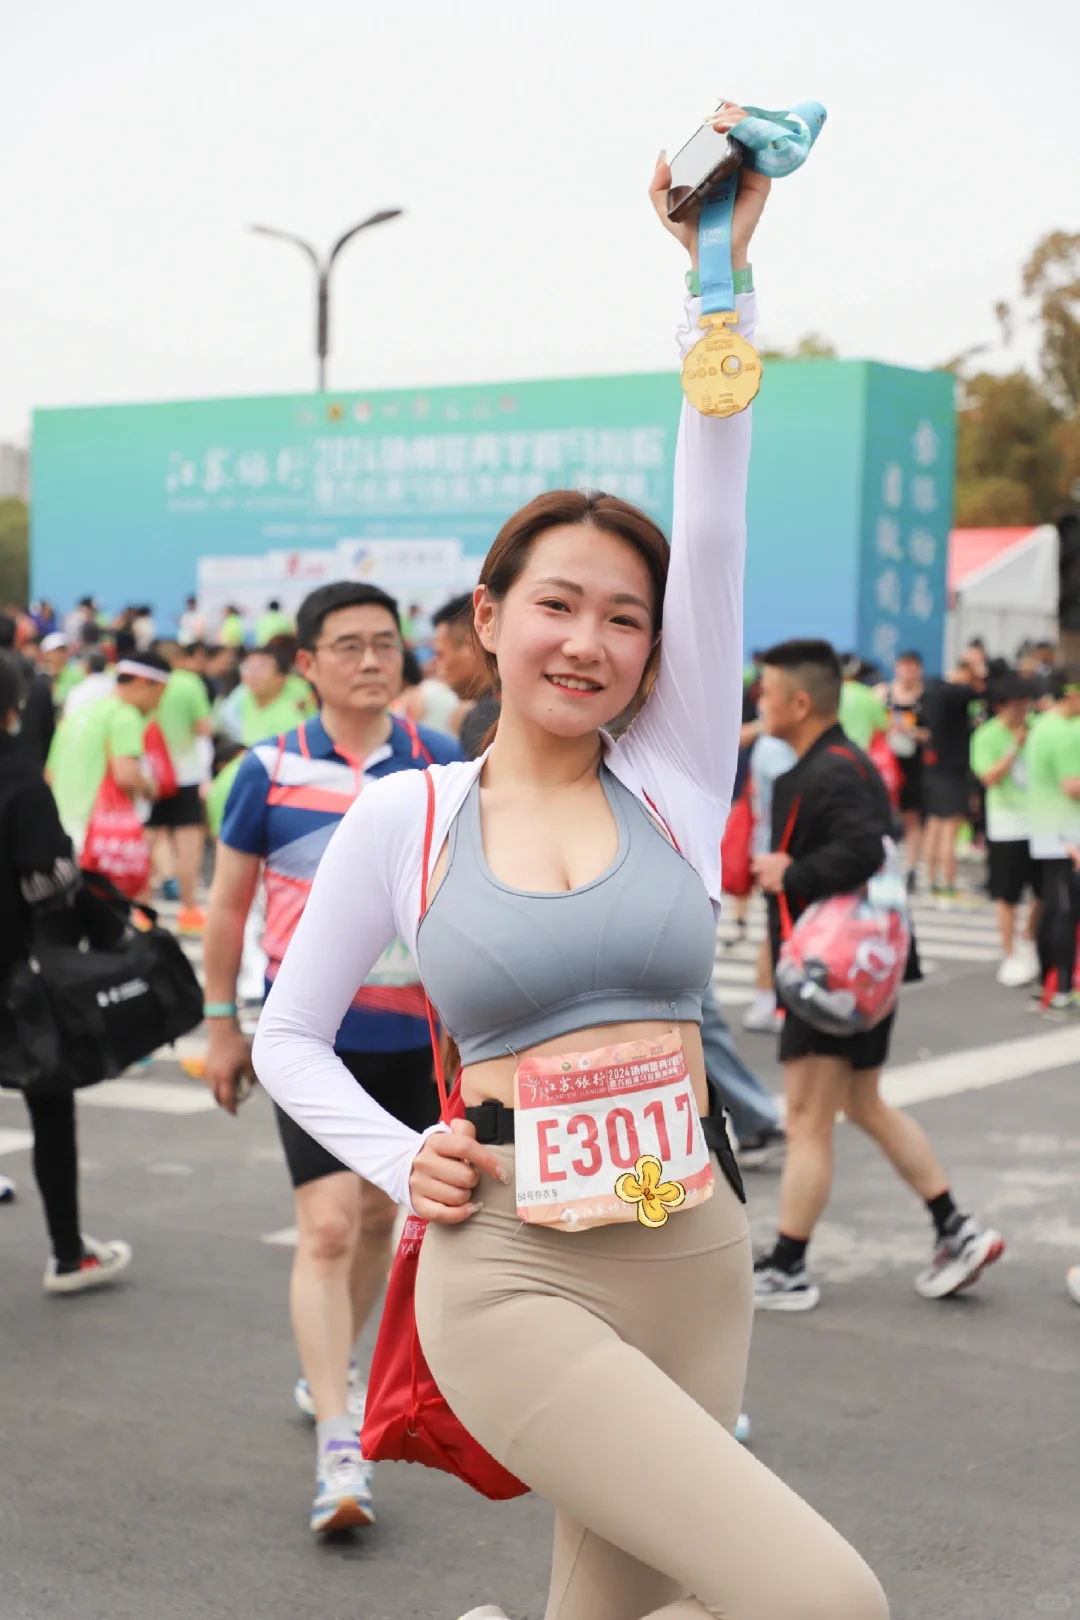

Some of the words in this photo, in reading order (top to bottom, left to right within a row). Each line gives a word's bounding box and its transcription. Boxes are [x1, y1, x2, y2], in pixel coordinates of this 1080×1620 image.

[545, 1072, 605, 1094] 江苏银行
[536, 1092, 694, 1184] E3017
[517, 1187, 559, 1203] 54号存衣车
